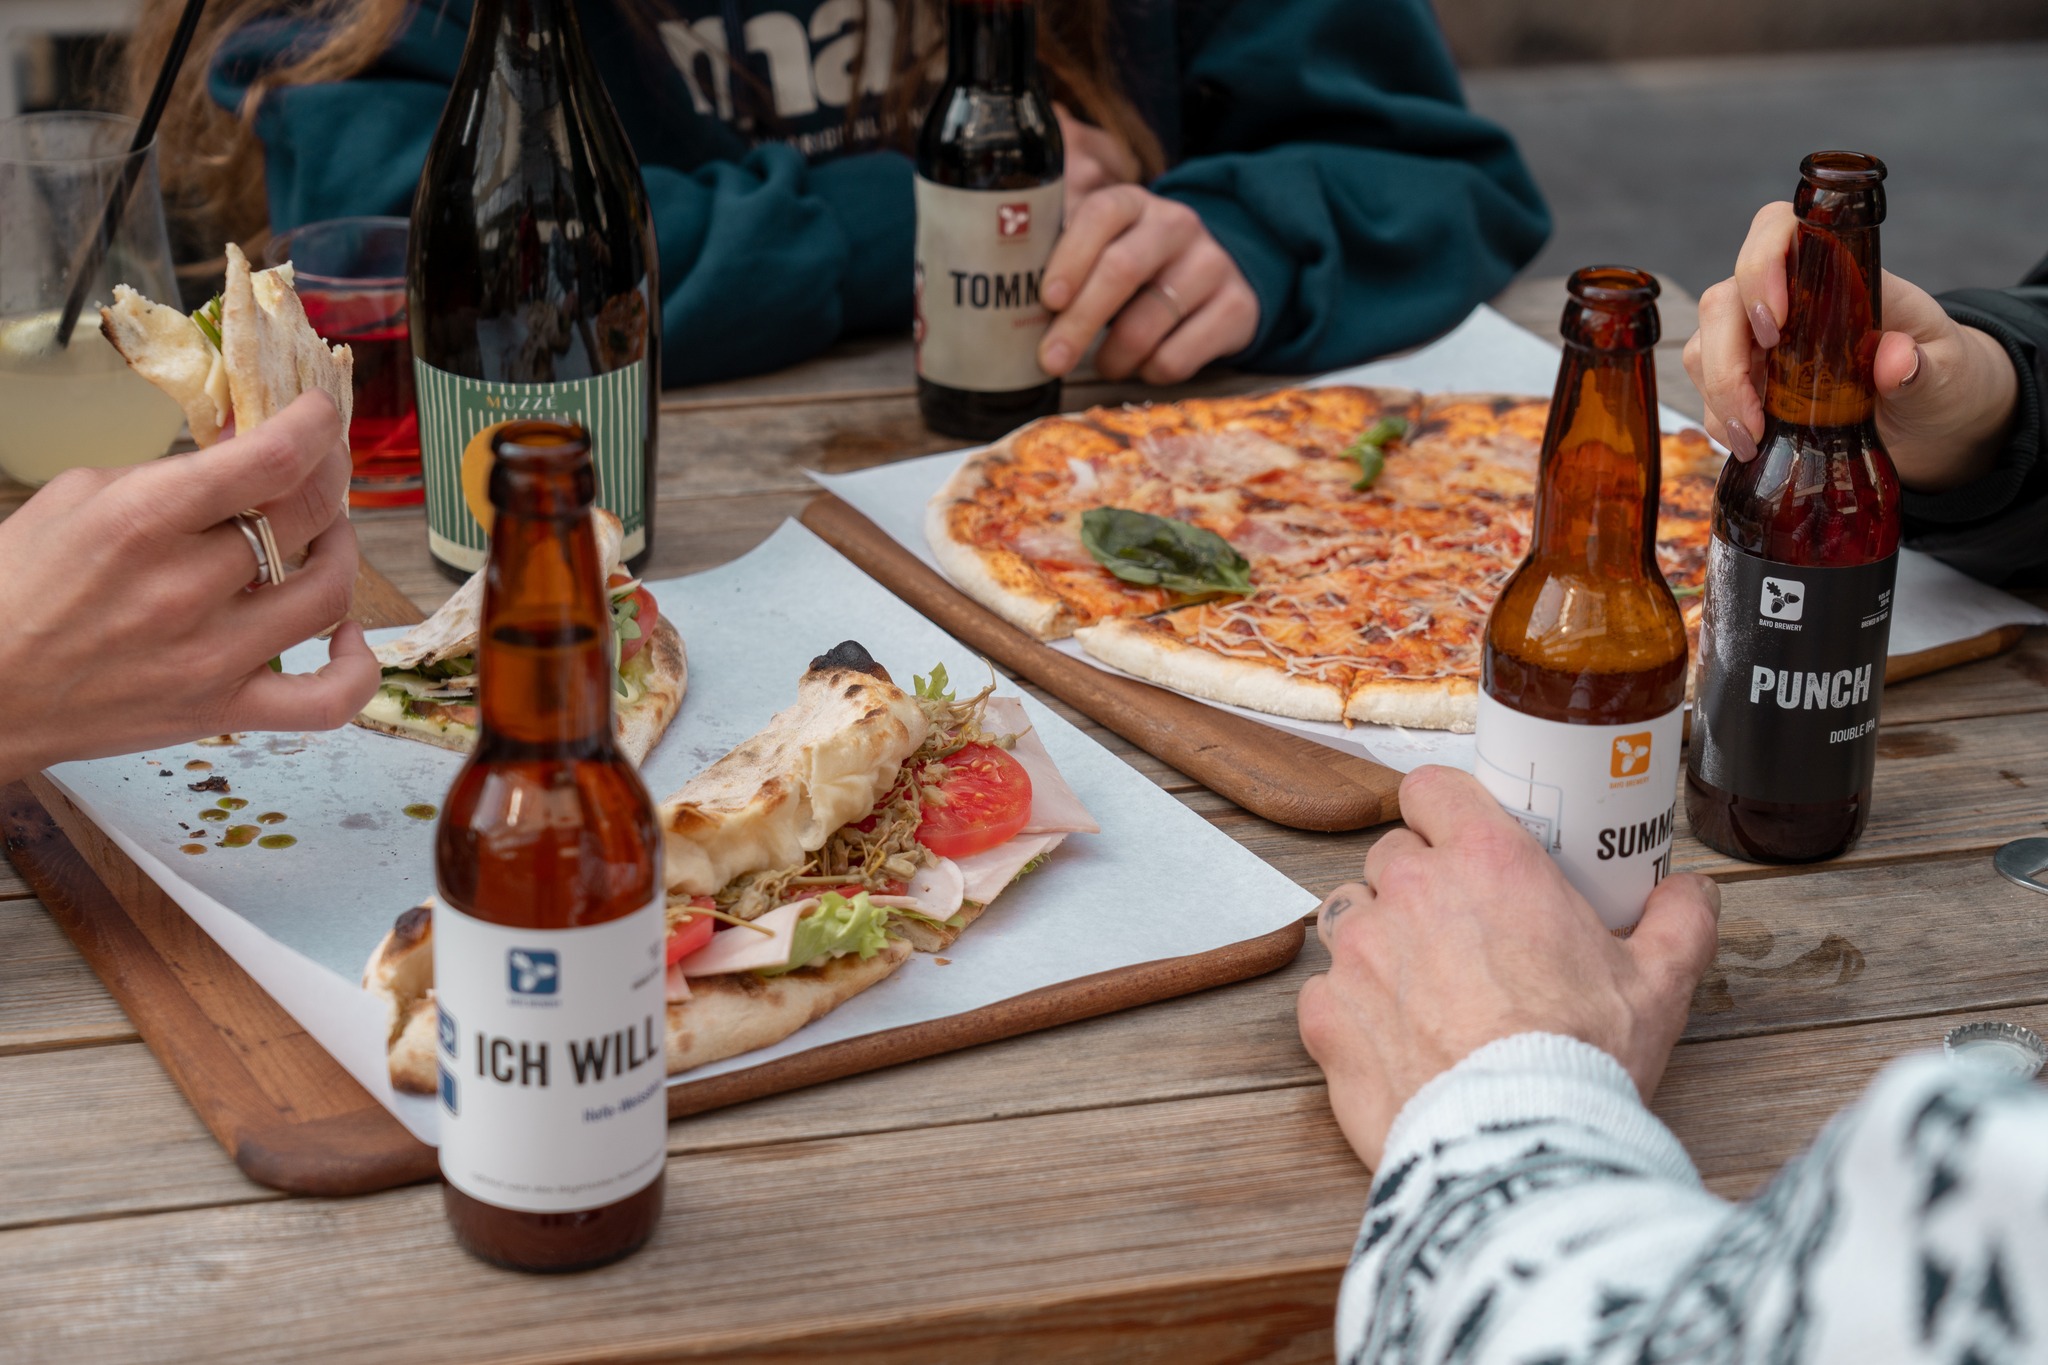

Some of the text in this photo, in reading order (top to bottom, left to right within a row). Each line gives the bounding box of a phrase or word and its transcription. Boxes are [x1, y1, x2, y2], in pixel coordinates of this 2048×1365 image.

[486, 392, 558, 411] MUZZÉ
[1758, 618, 1802, 632] BAYO BREWERY
[1750, 664, 1872, 709] PUNCH
[1829, 717, 1876, 743] DOUBLE IPA
[477, 1015, 659, 1087] ICH WILL
